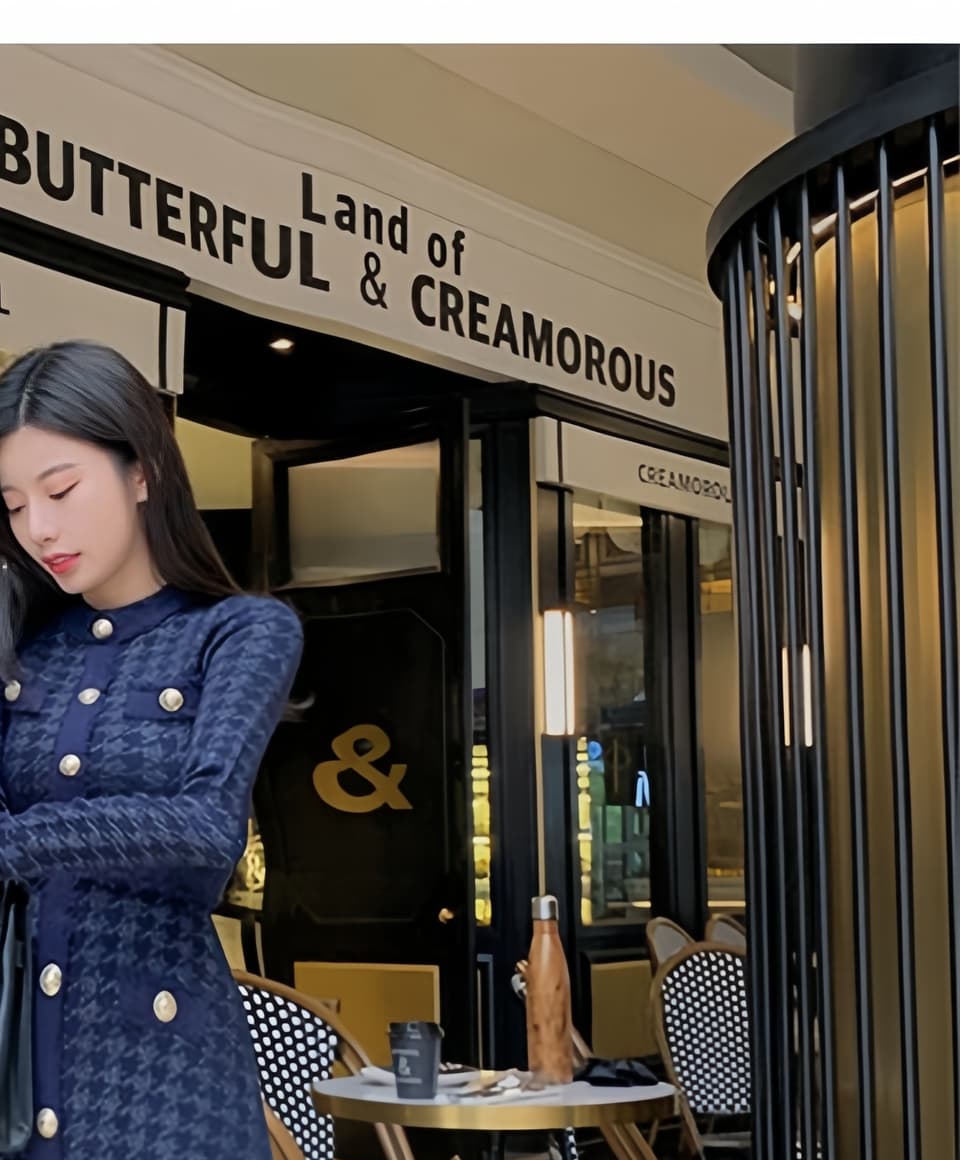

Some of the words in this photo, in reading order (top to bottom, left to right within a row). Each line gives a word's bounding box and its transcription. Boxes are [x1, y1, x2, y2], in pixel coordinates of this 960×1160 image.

[301, 172, 408, 255] Land
[427, 230, 466, 276] of
[360, 251, 388, 310] &
[411, 274, 676, 408] CREAMOROUS
[312, 724, 413, 813] &
